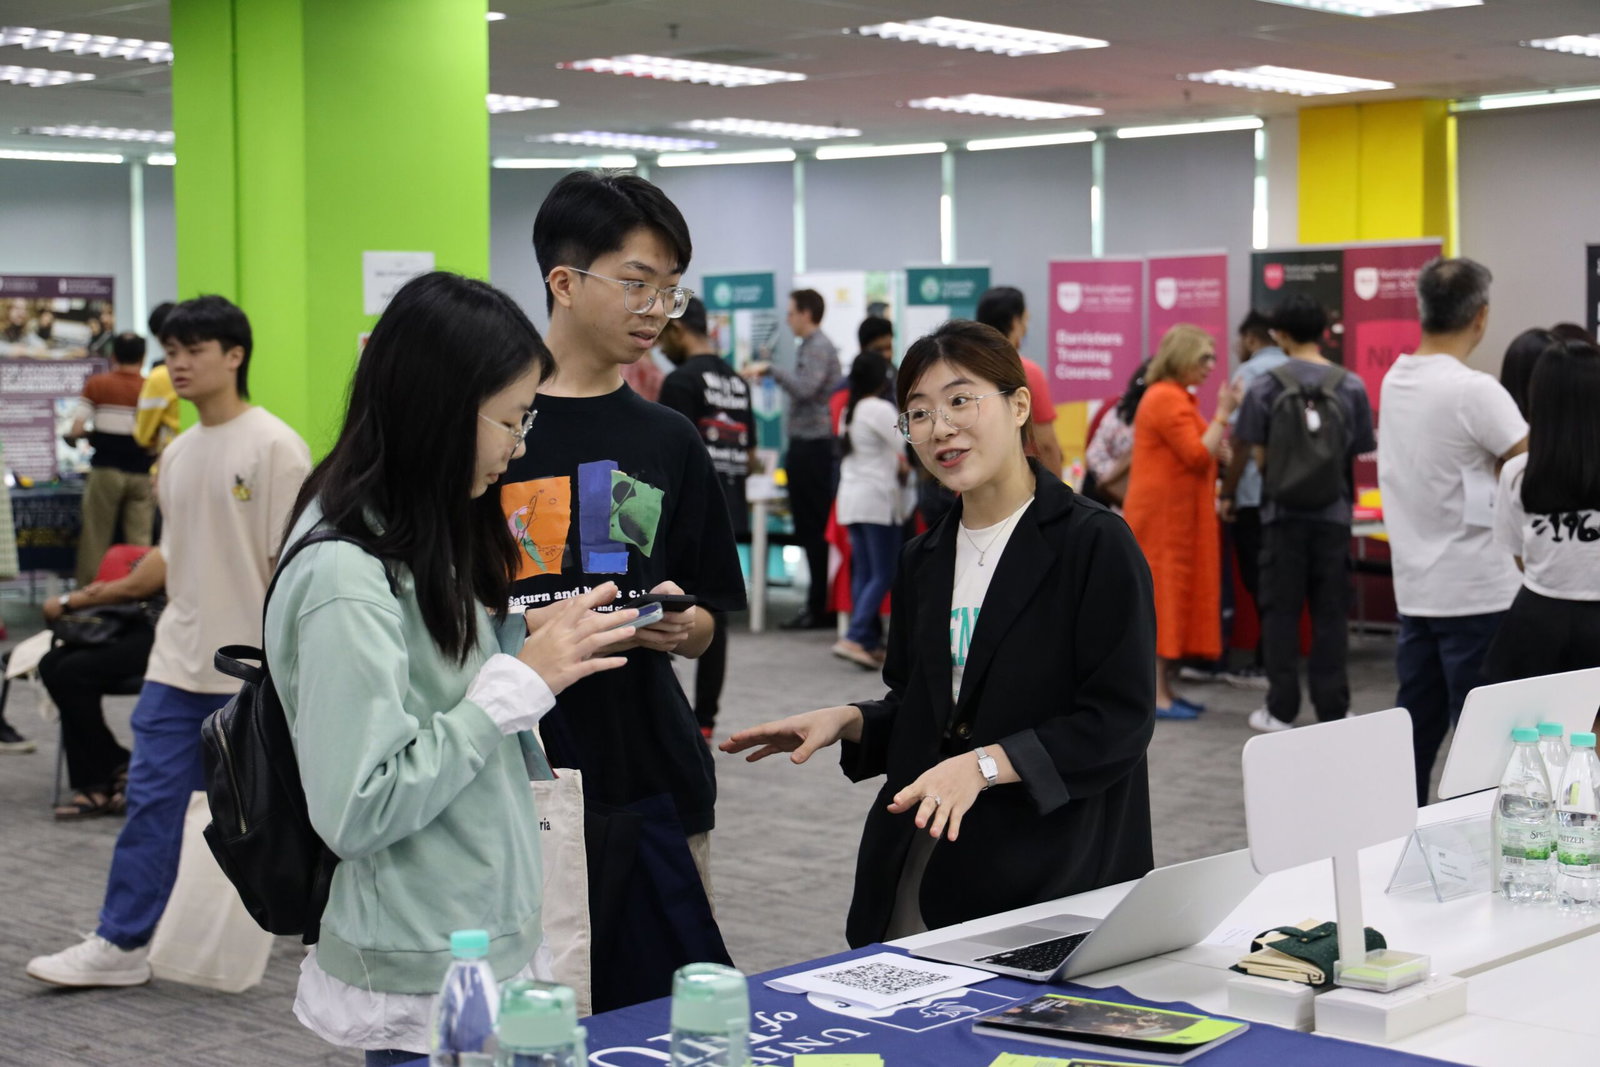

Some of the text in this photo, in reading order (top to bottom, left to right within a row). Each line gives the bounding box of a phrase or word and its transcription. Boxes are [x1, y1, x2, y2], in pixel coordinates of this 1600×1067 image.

[1057, 347, 1112, 366] Training
[1055, 363, 1112, 380] Courses
[508, 591, 551, 607] Saturn
[554, 586, 580, 600] and
[597, 604, 613, 612] and
[754, 1010, 798, 1032] of
